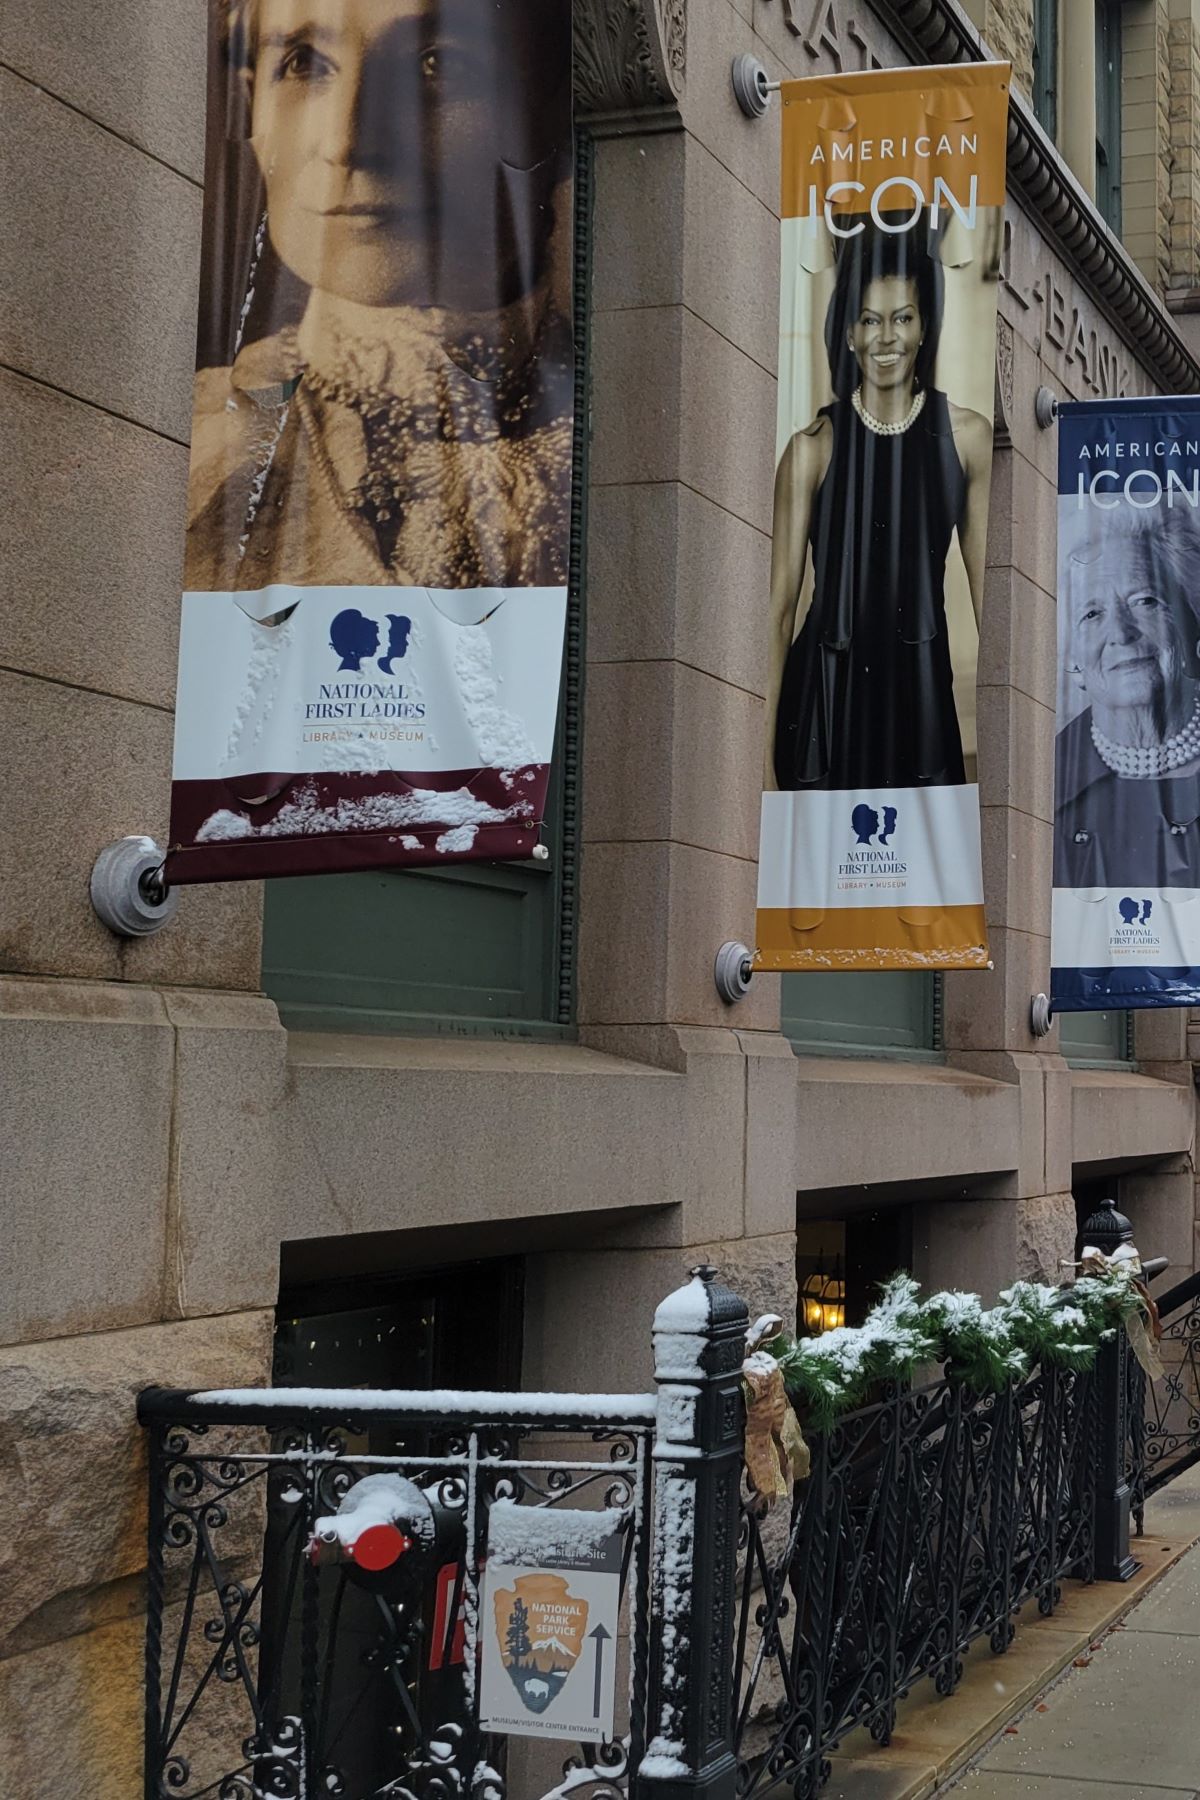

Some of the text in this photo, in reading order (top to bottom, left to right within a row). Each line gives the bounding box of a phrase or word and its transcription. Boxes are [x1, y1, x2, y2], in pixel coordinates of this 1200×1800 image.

[810, 134, 978, 165] AMERICAN
[808, 174, 979, 239] ICON
[1078, 440, 1199, 460] AMERICAN
[1077, 468, 1200, 511] ICON
[319, 683, 409, 700] NATIONAL
[305, 702, 426, 719] FIRST LADIES
[368, 730, 425, 742] MUSEUM
[847, 851, 898, 863] NATIONAL
[838, 862, 907, 875] FIRST LADIES
[837, 880, 907, 891] LIBRARY MUSEUM
[1115, 928, 1152, 937] NATIONAL
[1109, 936, 1160, 945] FIRST LADIES
[586, 1547, 607, 1560] Site
[531, 1602, 582, 1616] NATIONAL
[543, 1614, 570, 1626] PARK
[536, 1623, 577, 1637] SERVICE
[545, 1721, 568, 1731] CENTER
[568, 1723, 600, 1735] ENTRANCE
